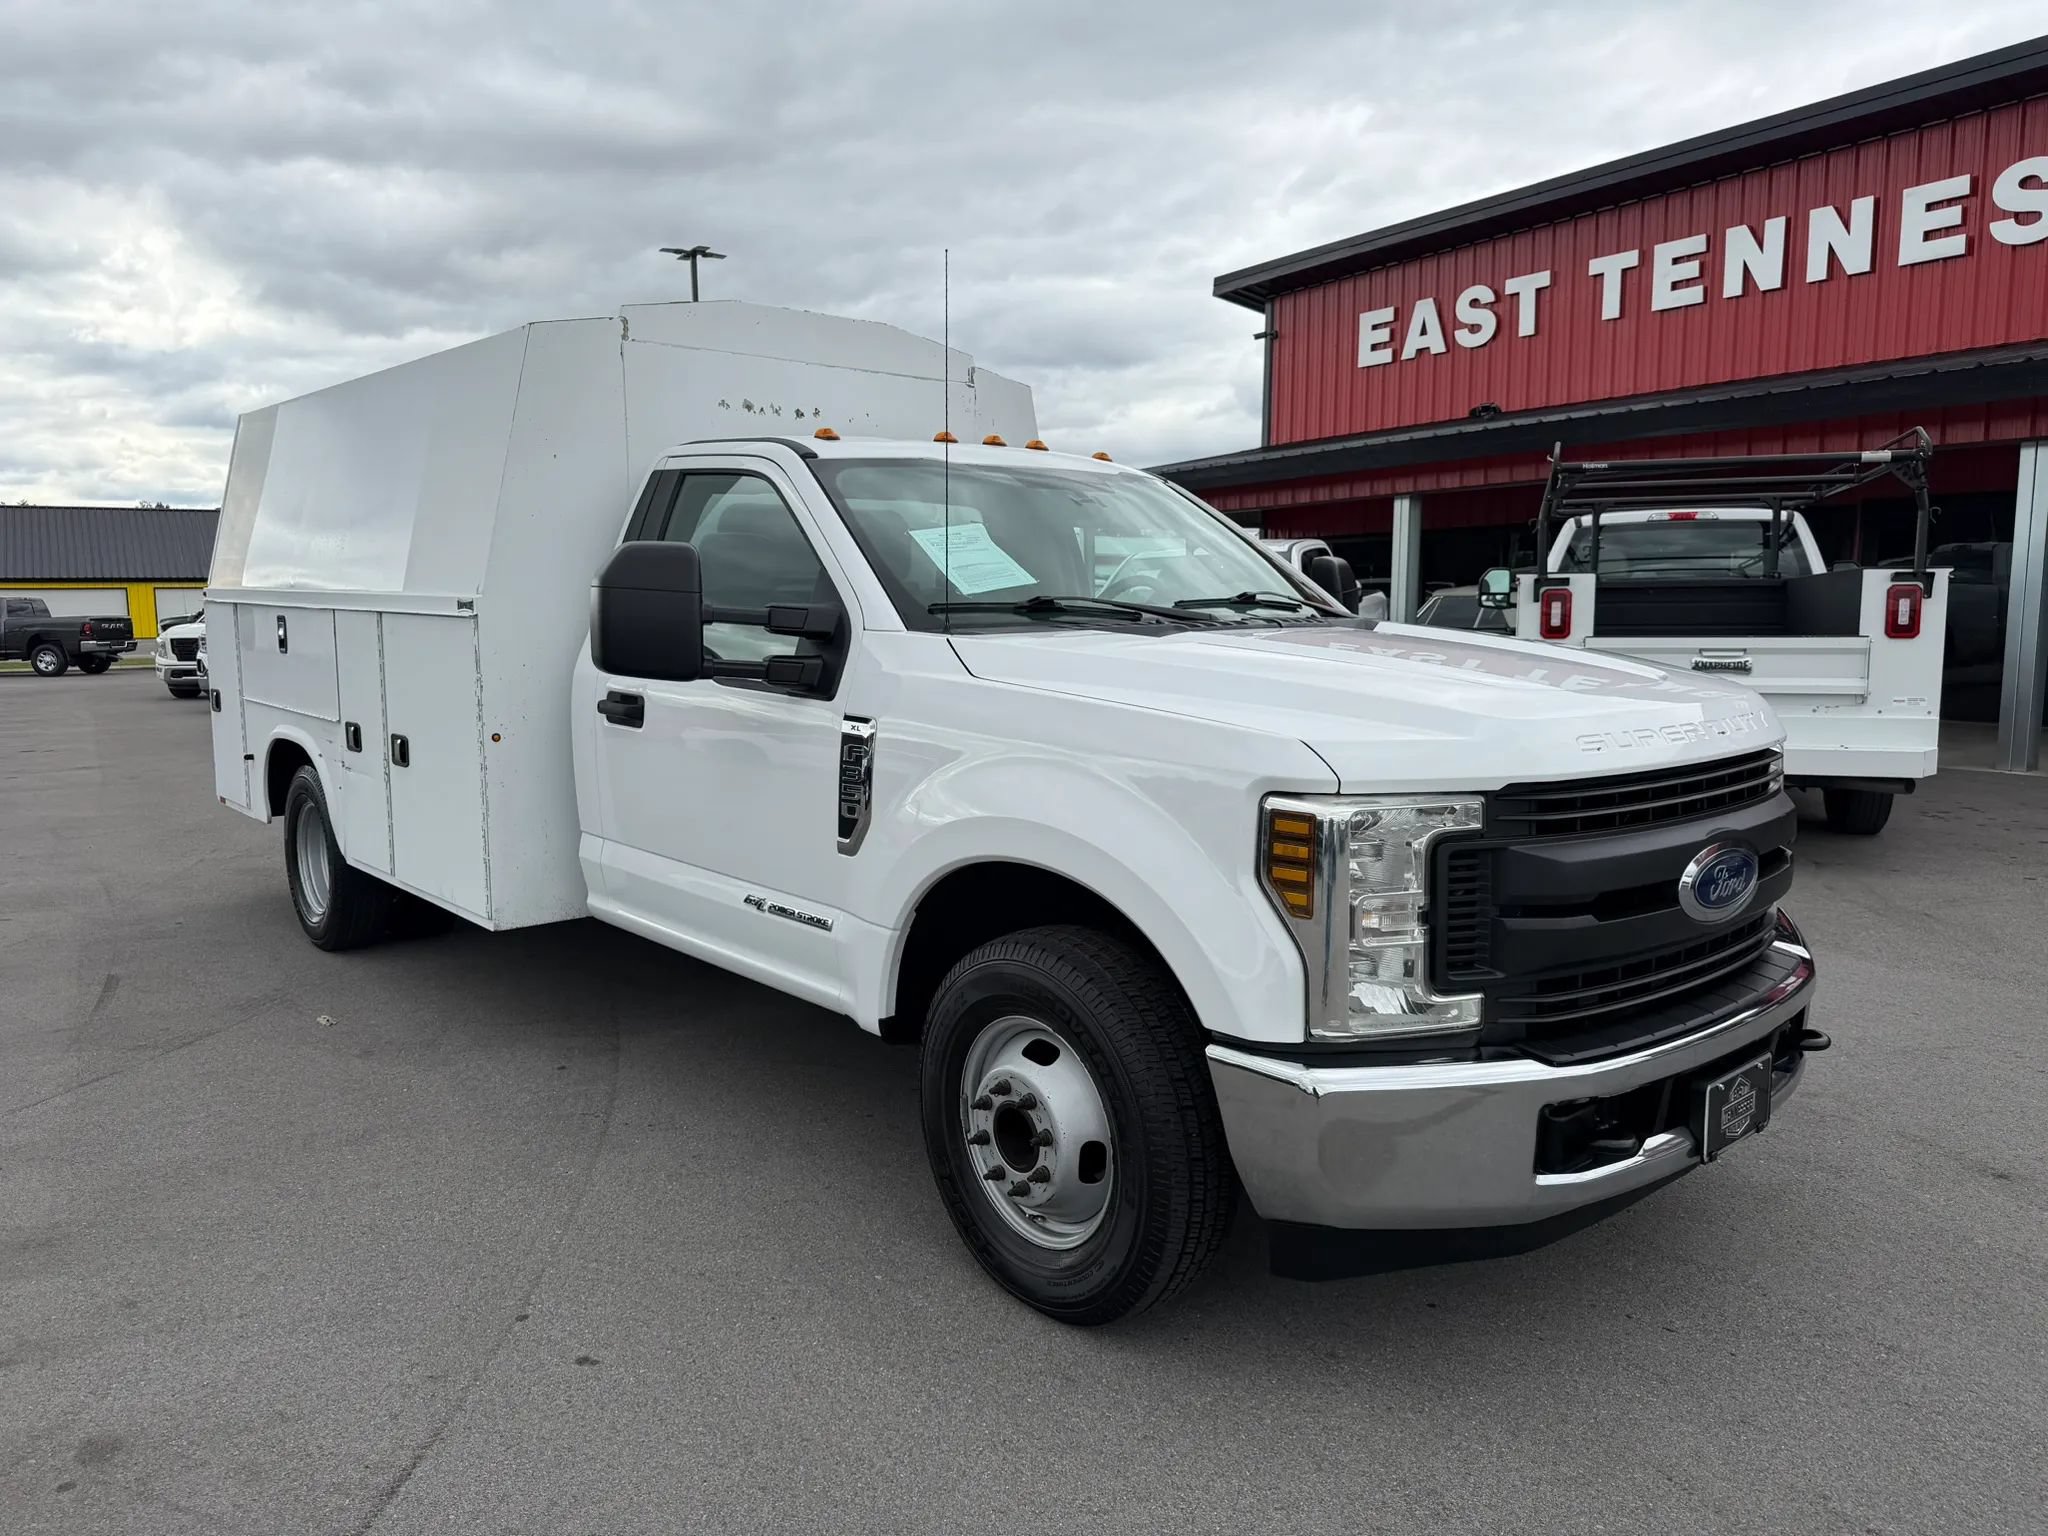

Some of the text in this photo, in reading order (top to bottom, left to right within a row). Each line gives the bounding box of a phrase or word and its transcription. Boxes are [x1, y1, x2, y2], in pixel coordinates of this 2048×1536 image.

[1357, 155, 2048, 369] EAST TENNES
[1692, 658, 1752, 673] KNAPHEIDE
[850, 724, 862, 733] XL
[1576, 721, 1706, 752] SUPER
[1710, 865, 1747, 901] Ford
[768, 902, 796, 917] POWER
[796, 911, 830, 927] STROKE
